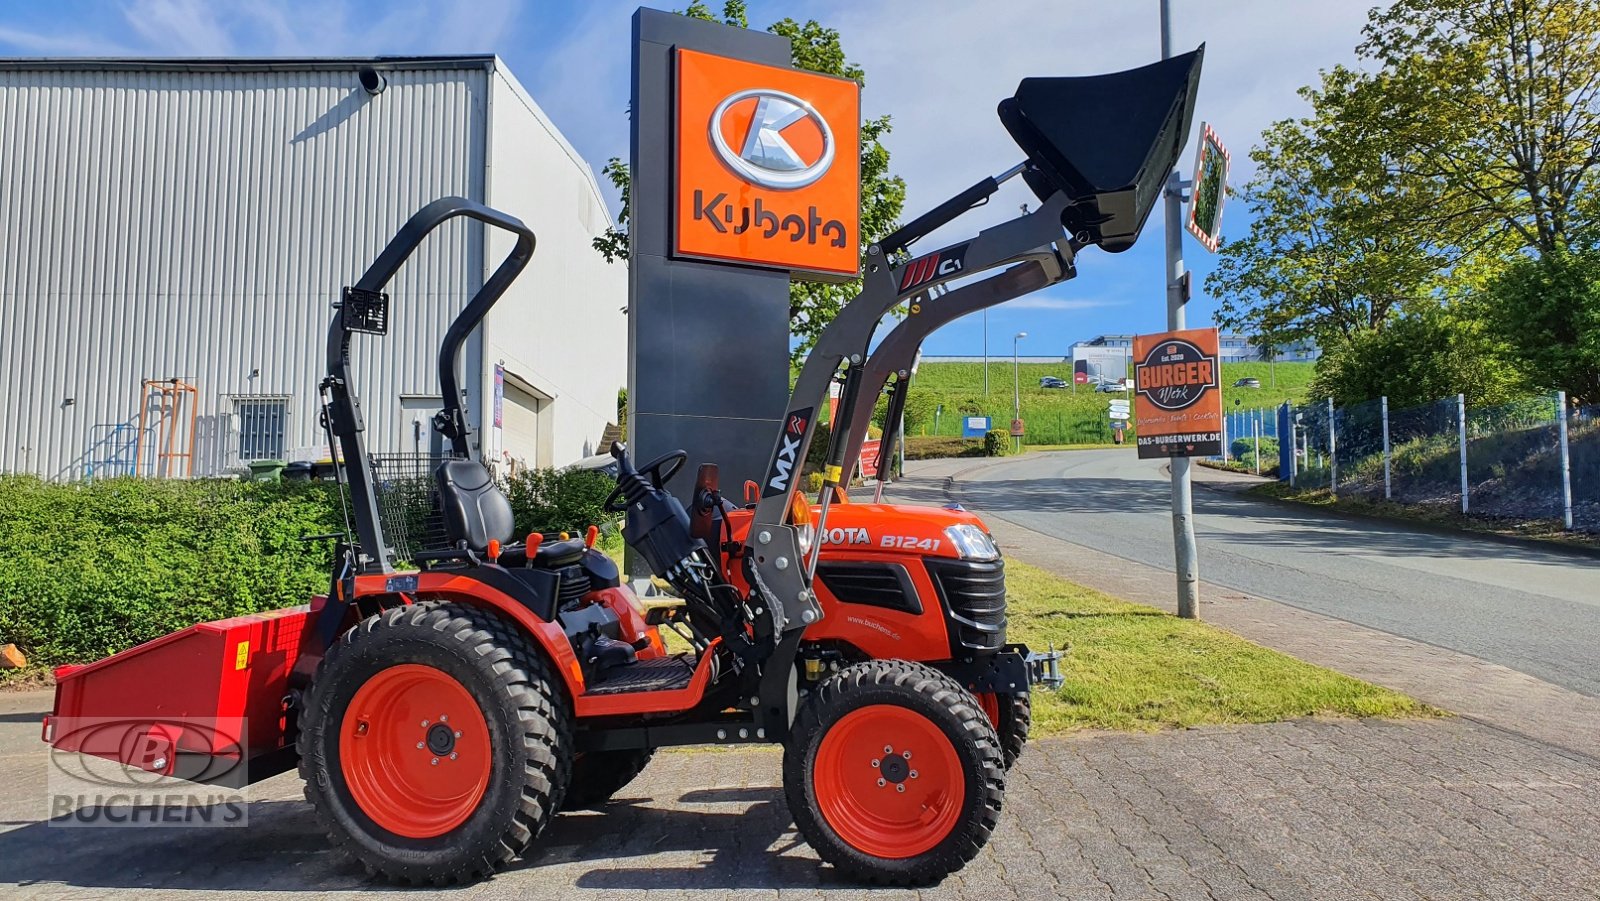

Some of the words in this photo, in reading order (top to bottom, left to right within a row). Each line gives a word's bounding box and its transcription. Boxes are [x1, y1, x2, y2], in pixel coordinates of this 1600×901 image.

[694, 189, 847, 248] Kubota
[939, 259, 962, 275] C1
[1140, 361, 1212, 389] BURGER
[1158, 385, 1188, 403] Werk
[1138, 433, 1221, 445] DAS-BURGERWERK.DE
[770, 434, 800, 491] MX
[820, 527, 871, 545] BOTA
[880, 535, 940, 551] B1241
[847, 615, 901, 640] www.buchens.de
